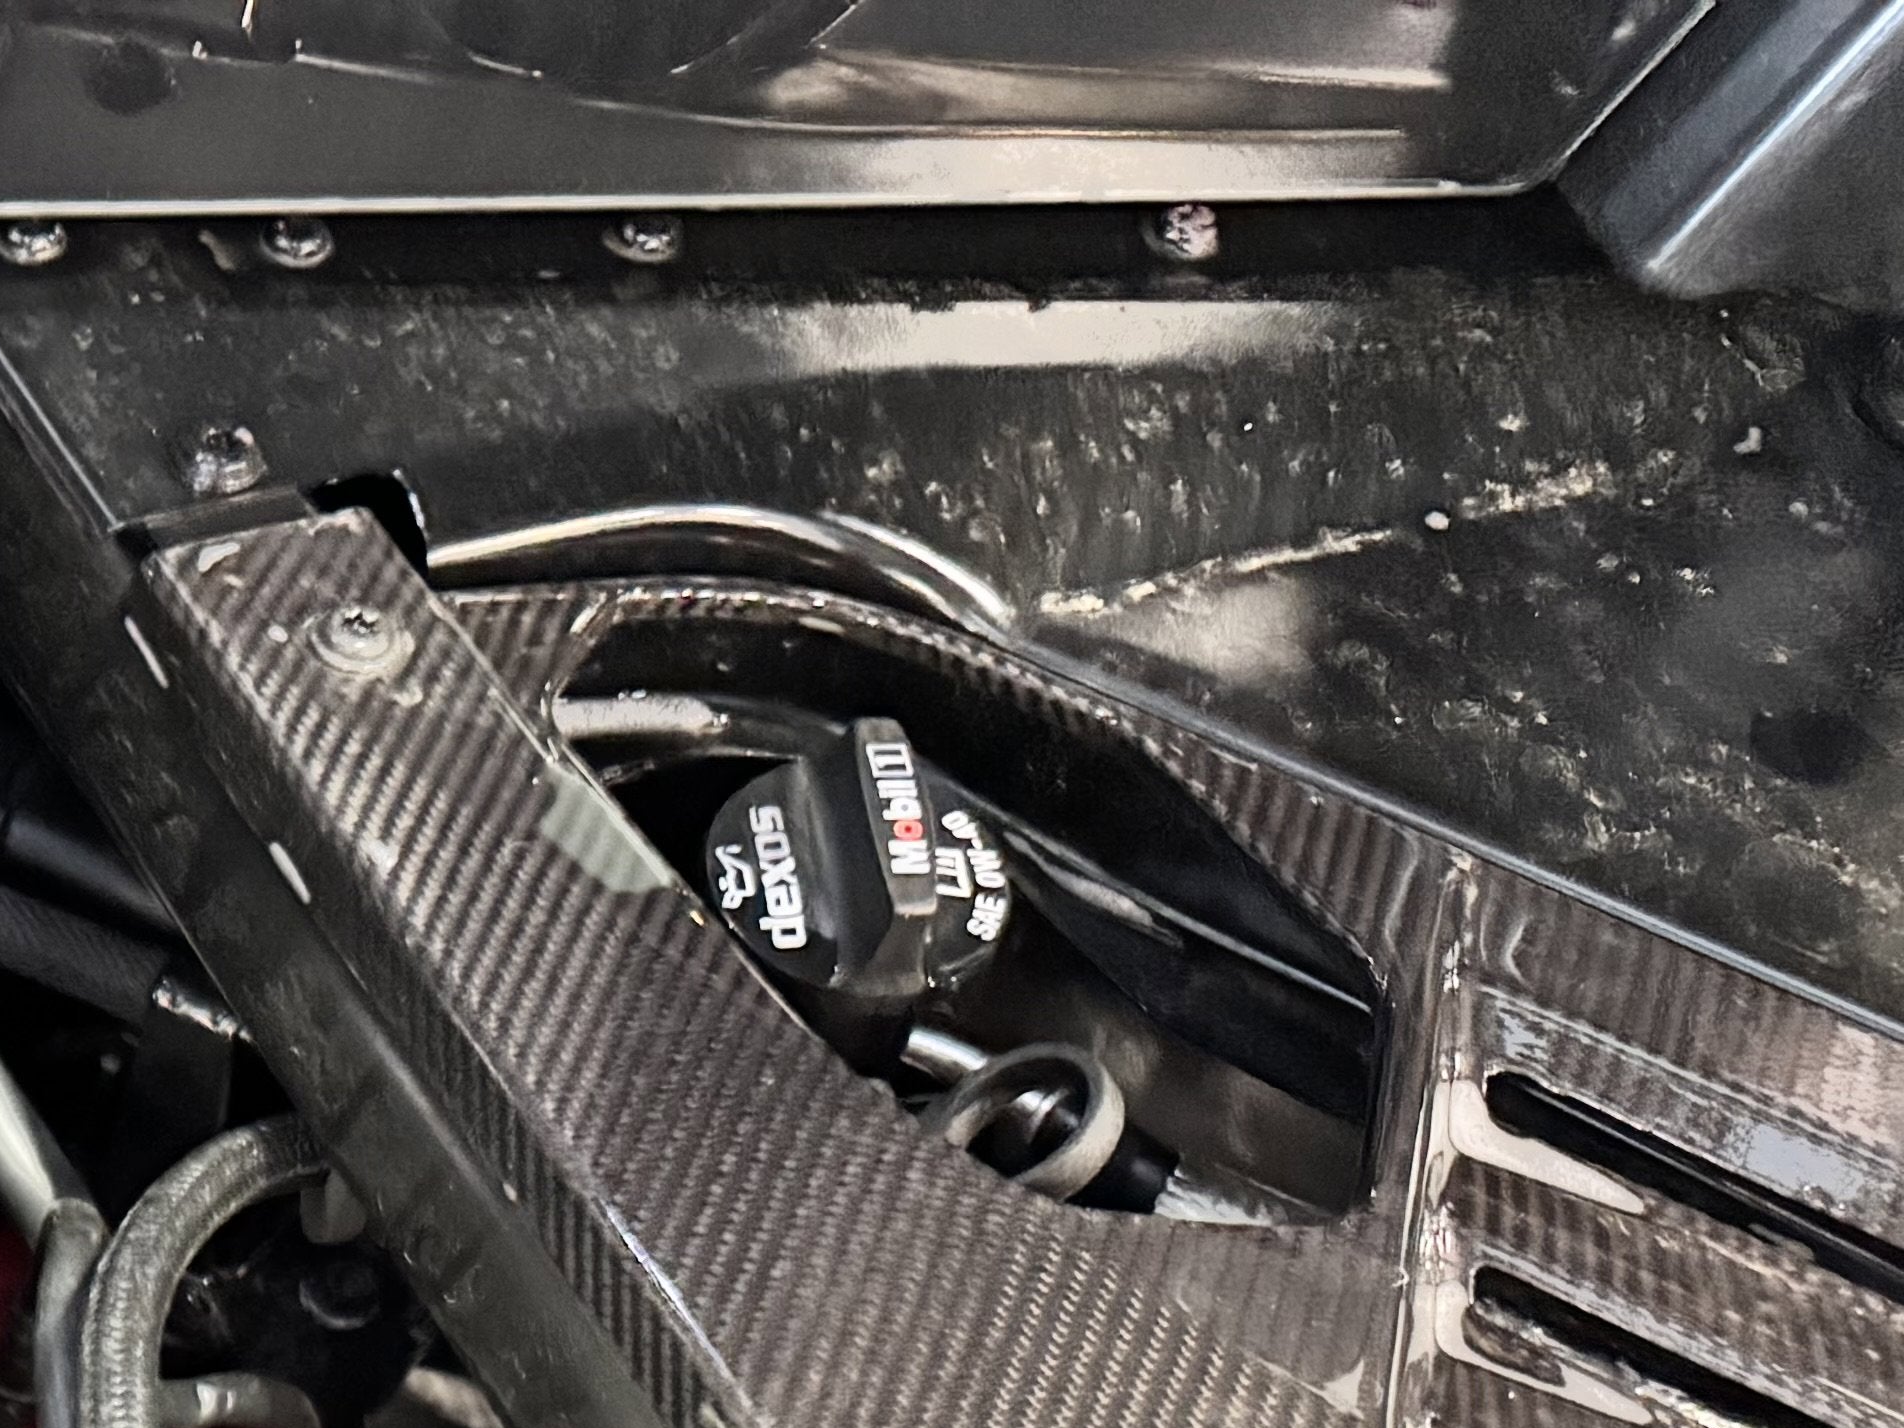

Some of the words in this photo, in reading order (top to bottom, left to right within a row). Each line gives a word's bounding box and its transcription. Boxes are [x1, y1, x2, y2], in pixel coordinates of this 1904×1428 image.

[876, 779, 931, 874] Mobil
[941, 810, 1006, 888] 0W-40
[748, 805, 807, 949] dexos
[966, 893, 1007, 941] SAE
